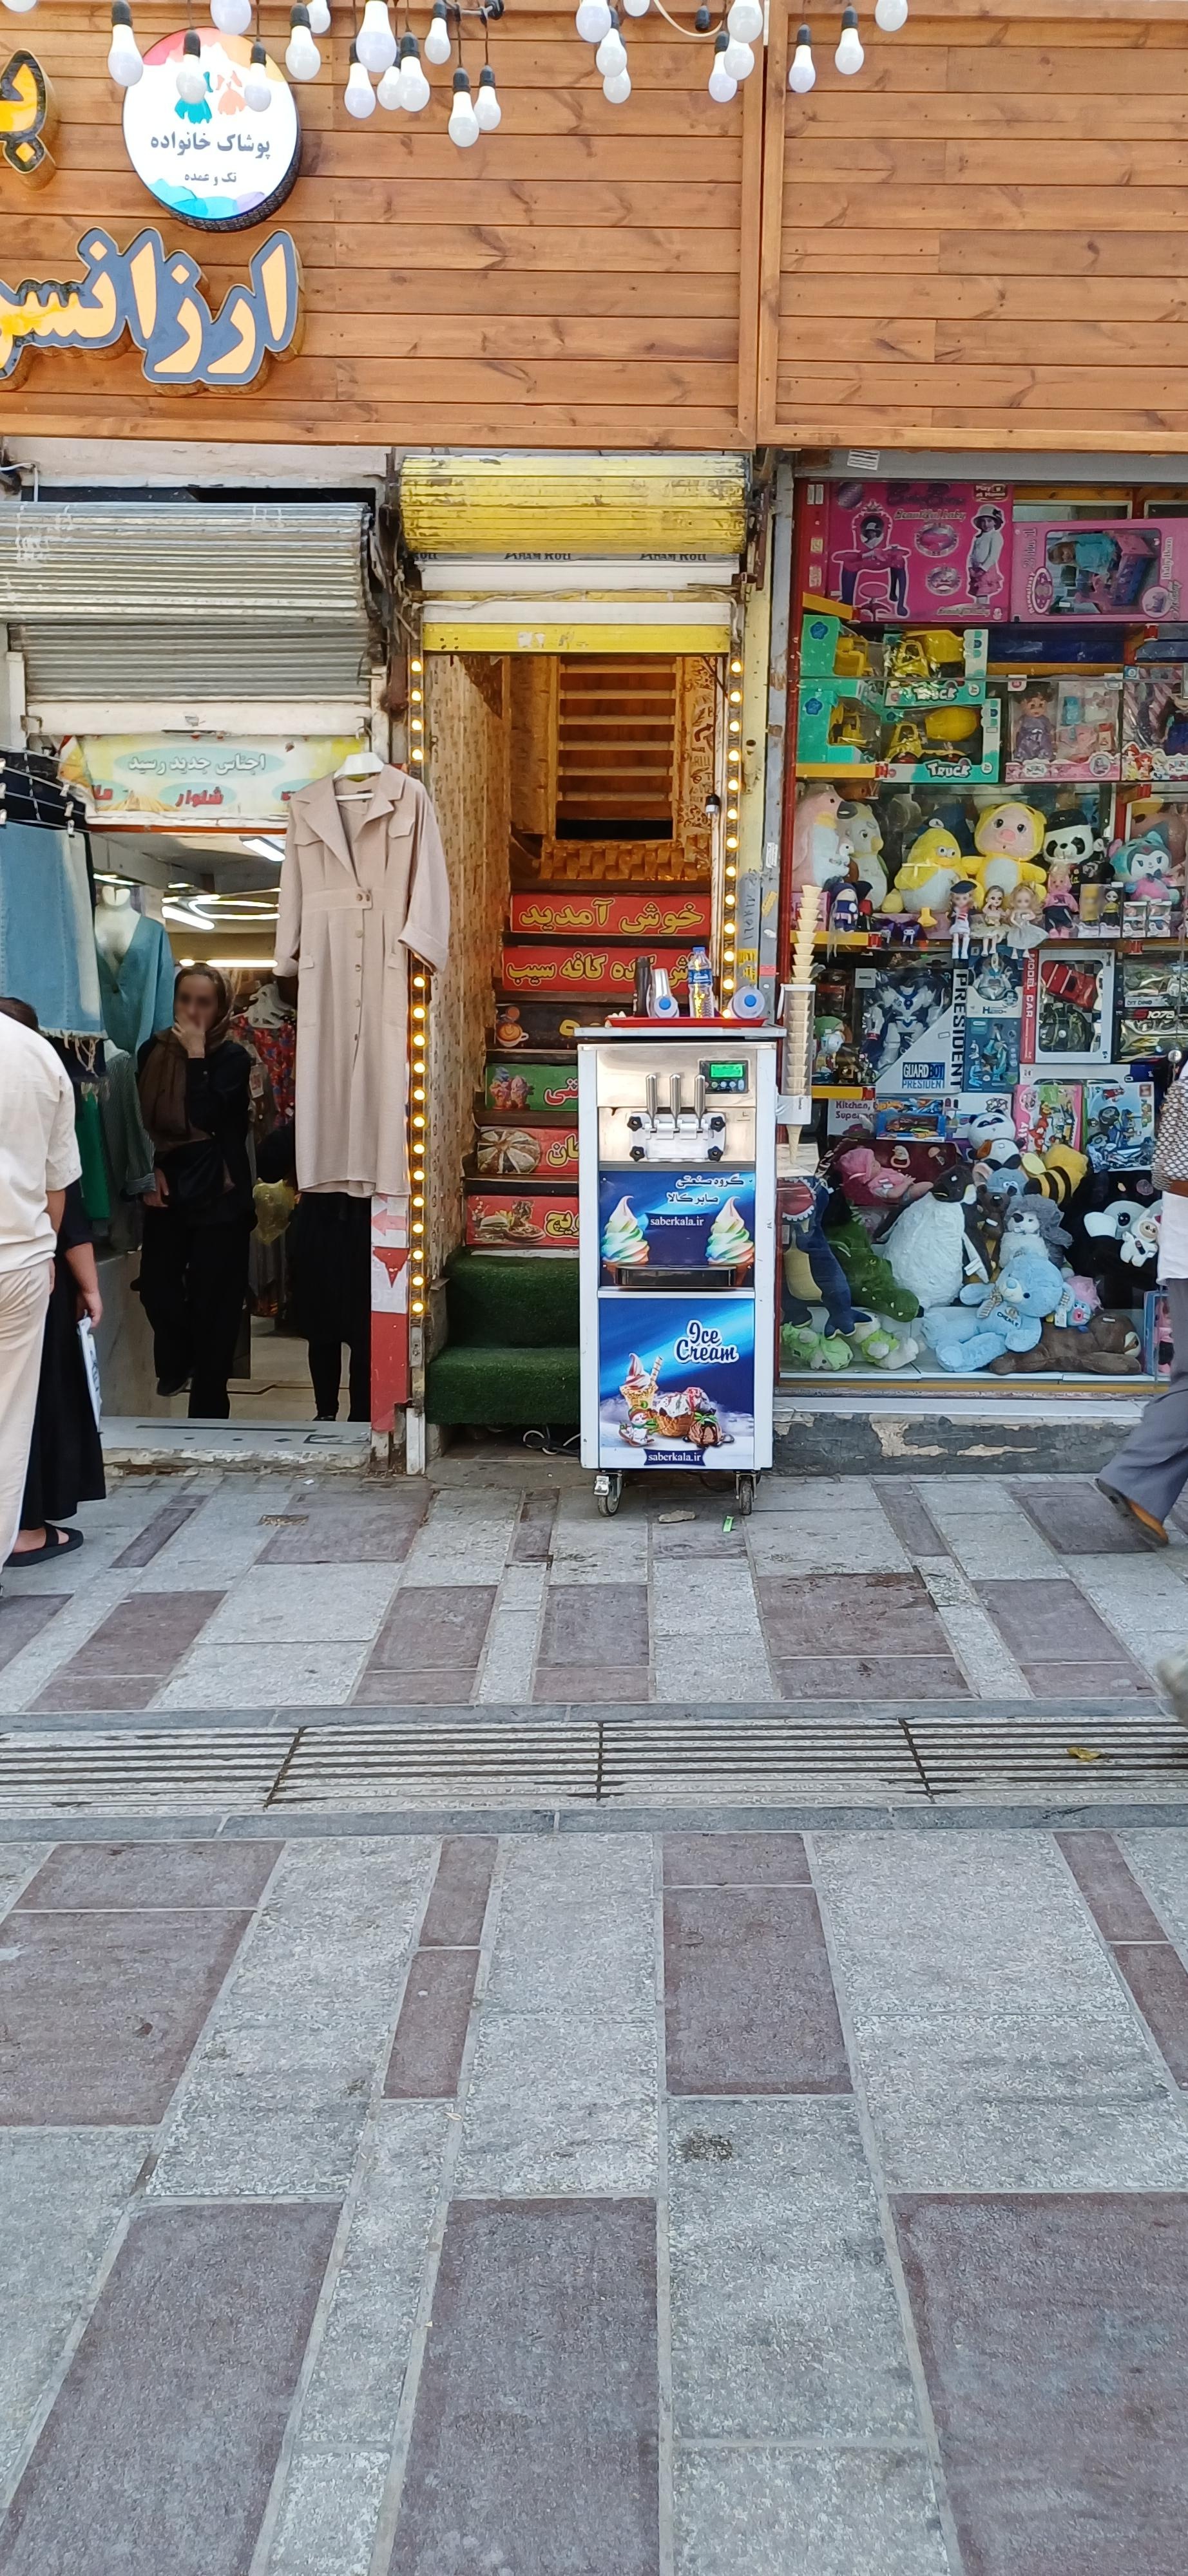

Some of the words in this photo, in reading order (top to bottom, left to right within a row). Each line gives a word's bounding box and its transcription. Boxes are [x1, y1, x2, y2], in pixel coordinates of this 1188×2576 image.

[150, 131, 211, 155] خانواده
[216, 133, 271, 160] پوشاک
[184, 171, 210, 182] عمده
[213, 177, 219, 185] و
[222, 170, 238, 183] تک
[0, 240, 294, 374] ارزانس
[128, 756, 166, 774] رسید
[169, 755, 211, 774] جدید
[216, 753, 266, 775] اجناس
[928, 762, 970, 777] TRUCK
[175, 787, 224, 807] شلوار
[521, 899, 614, 930] آمدید
[619, 902, 704, 934] خوش
[506, 958, 557, 985] سیب
[560, 953, 609, 982] کافه
[1026, 994, 1034, 1018] CAR
[950, 973, 968, 1088] PRESIDENT
[836, 1100, 870, 1110] Kitchen,
[676, 1175, 712, 1188] صنعتی
[714, 1173, 744, 1188] گروه
[667, 1193, 693, 1202] کالا
[695, 1193, 718, 1205] صابر
[650, 1216, 705, 1226] saberkala.ir
[689, 1322, 720, 1345] Ice
[676, 1338, 737, 1361] Cream
[648, 1450, 702, 1462] saberkala.ir
